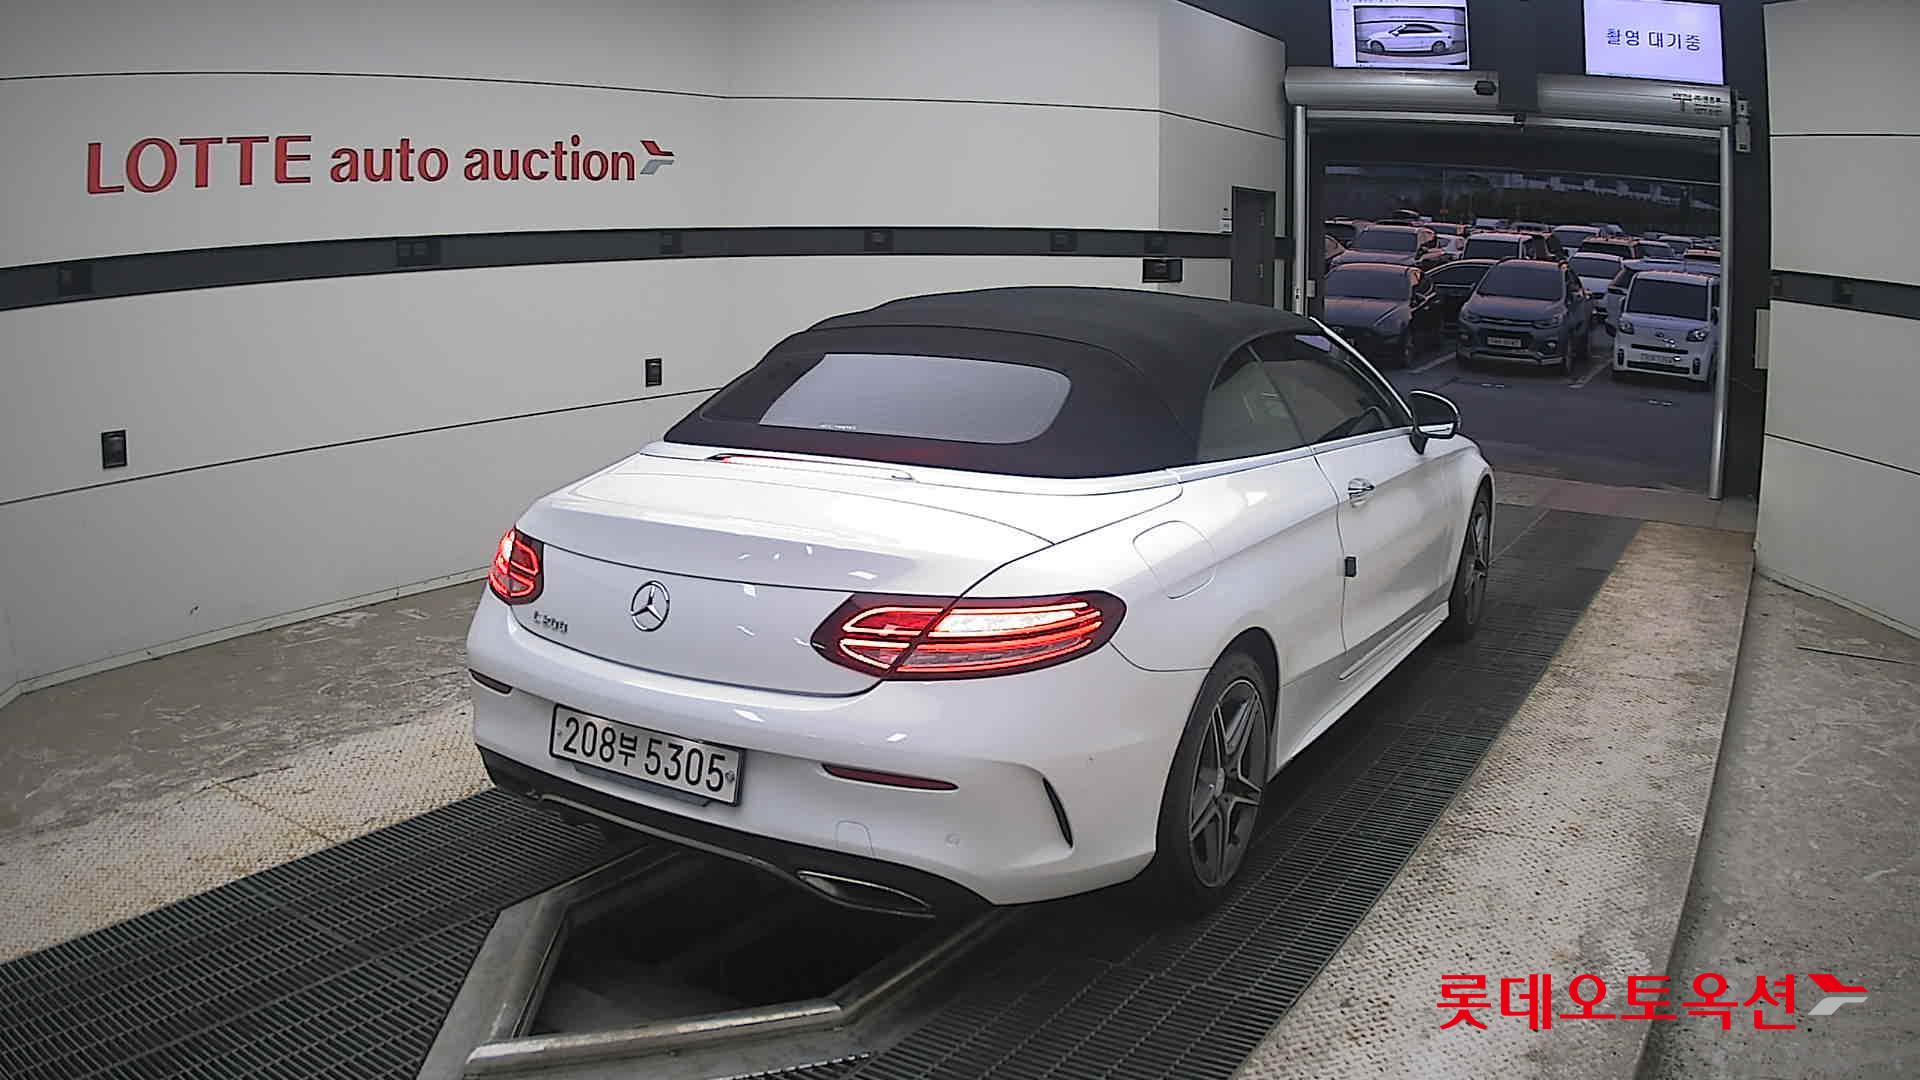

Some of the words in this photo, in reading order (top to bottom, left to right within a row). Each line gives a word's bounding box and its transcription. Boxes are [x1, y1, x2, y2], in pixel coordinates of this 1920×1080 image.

[1648, 31, 1701, 52] 대기중
[86, 134, 312, 195] LOTTE
[329, 137, 449, 182] auto
[463, 133, 636, 182] auction
[562, 716, 638, 768] 208부
[643, 738, 727, 793] 5305
